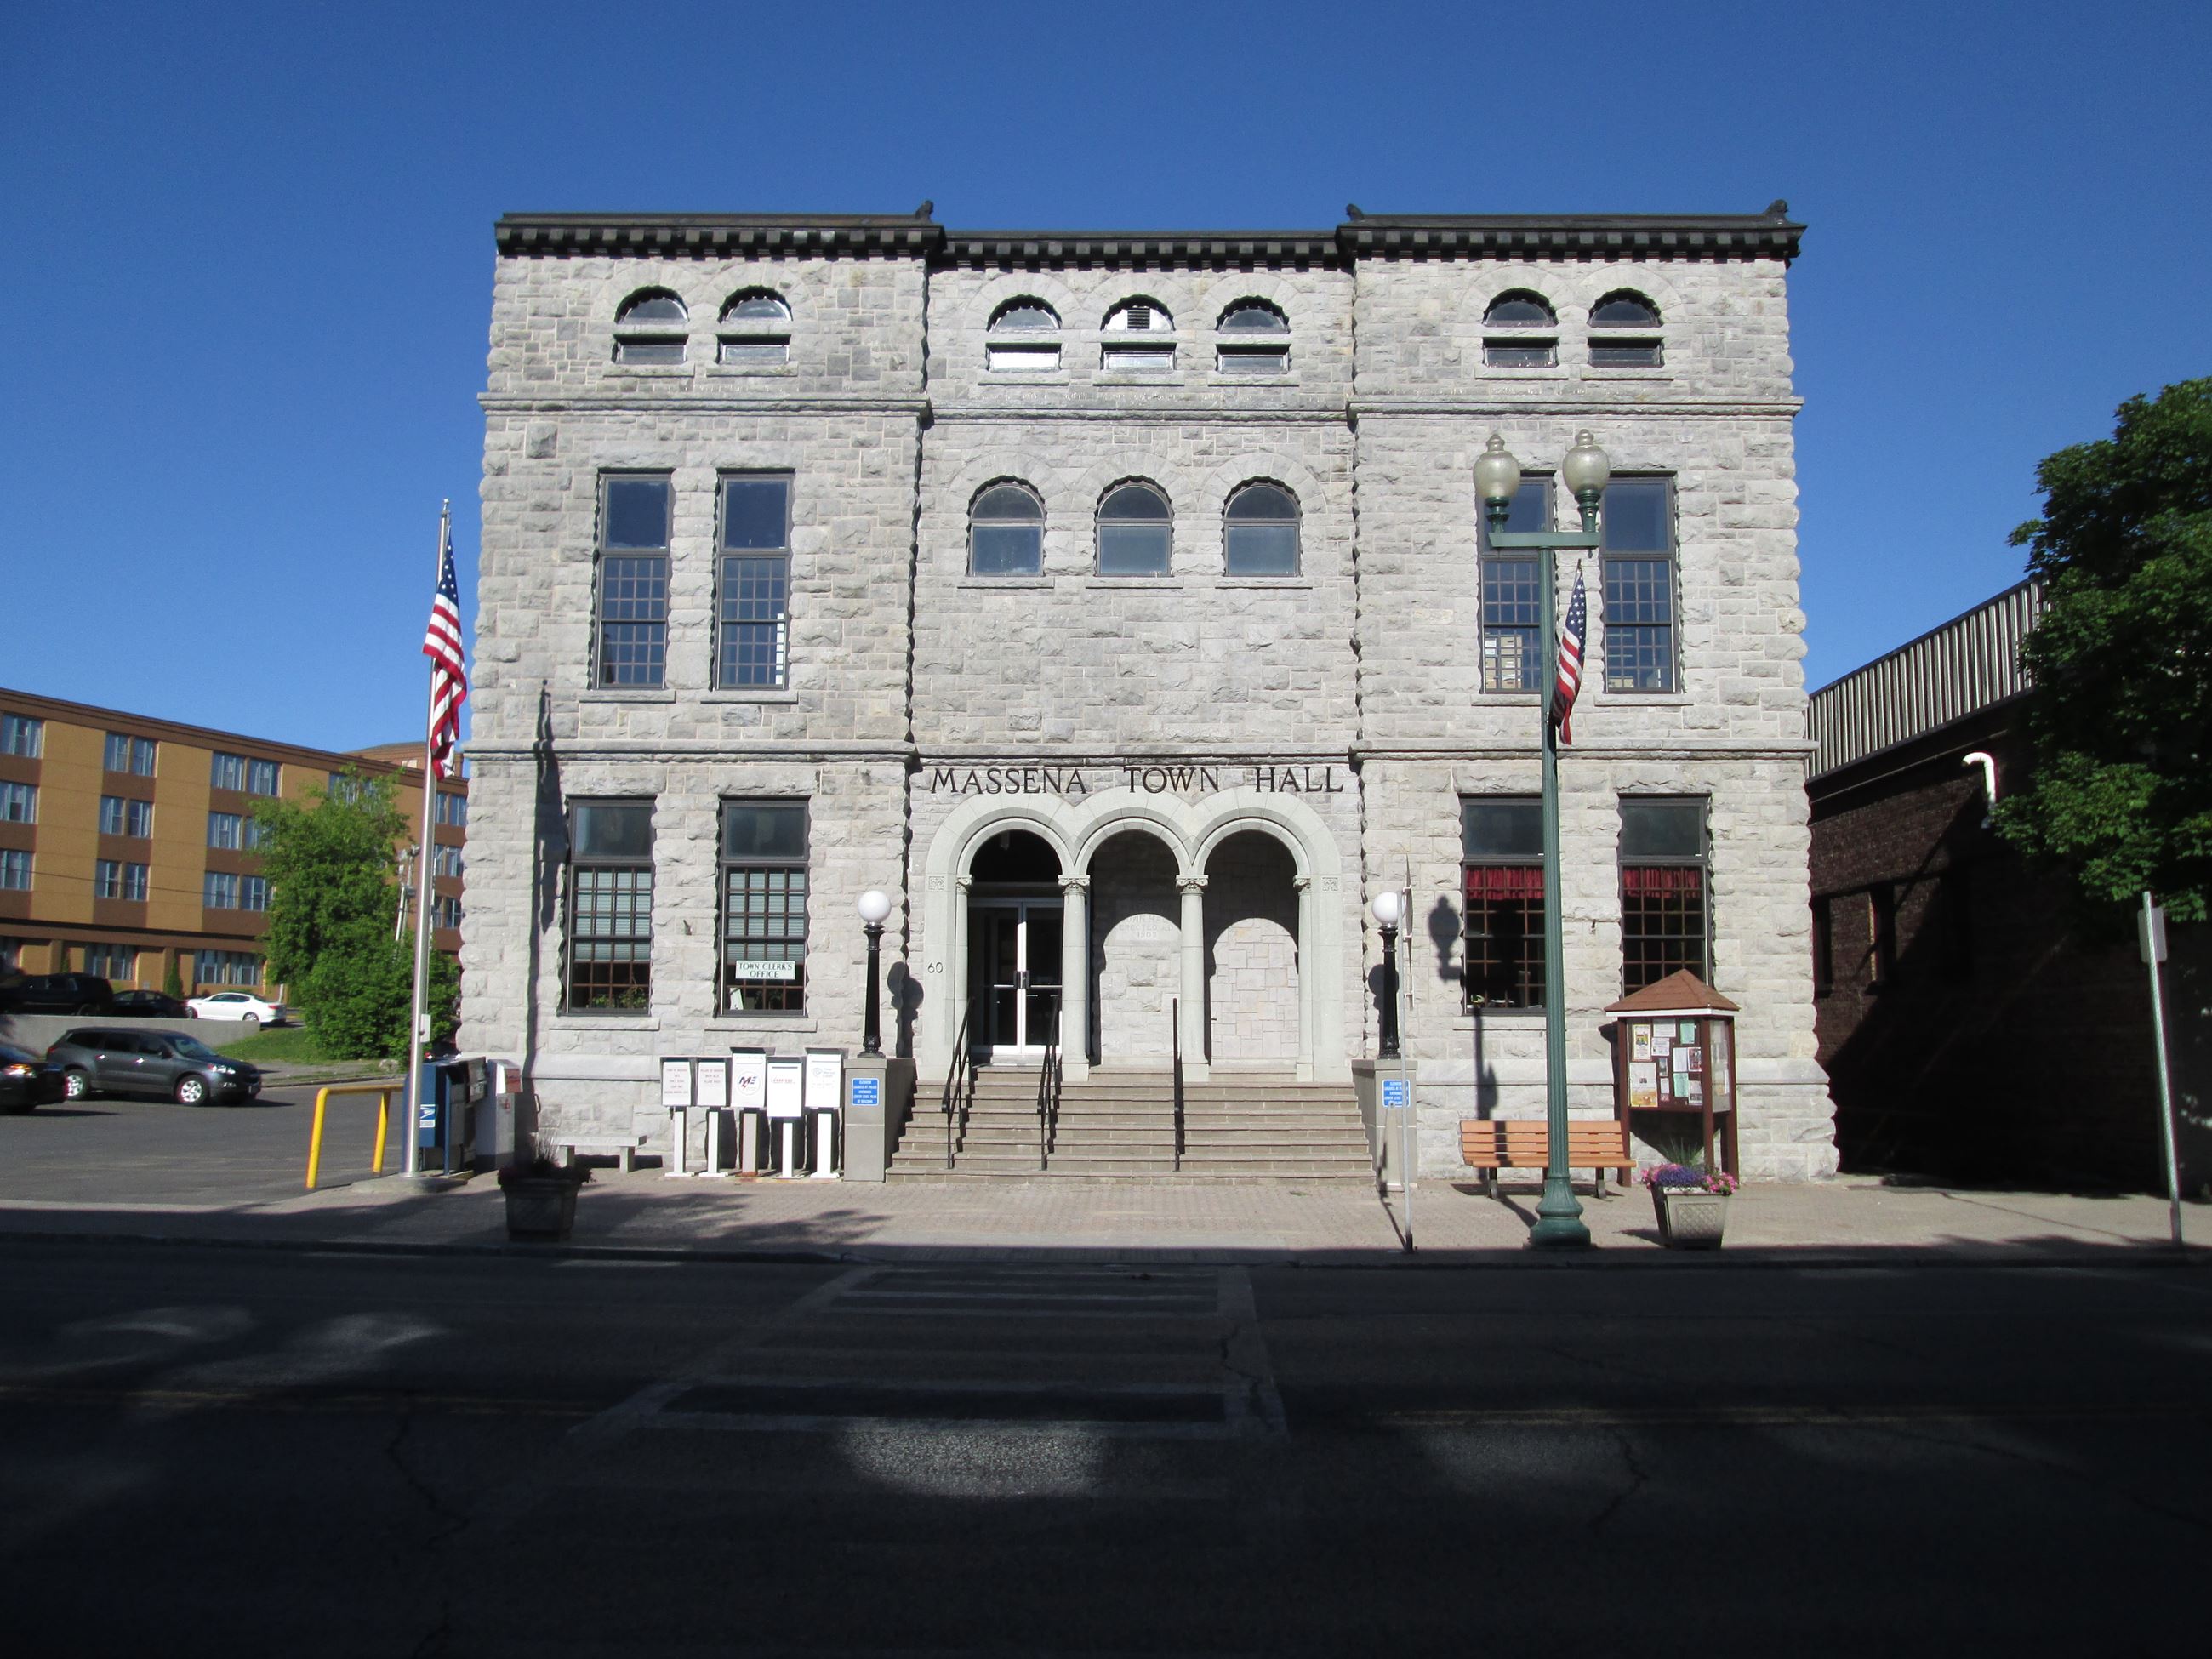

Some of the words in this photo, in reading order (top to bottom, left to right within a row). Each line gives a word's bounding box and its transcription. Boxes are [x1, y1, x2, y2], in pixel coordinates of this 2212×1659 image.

[930, 767, 1087, 794] MASSENA
[1123, 767, 1219, 793] TOWN
[1256, 767, 1343, 793] HALL
[927, 961, 944, 974] 60
